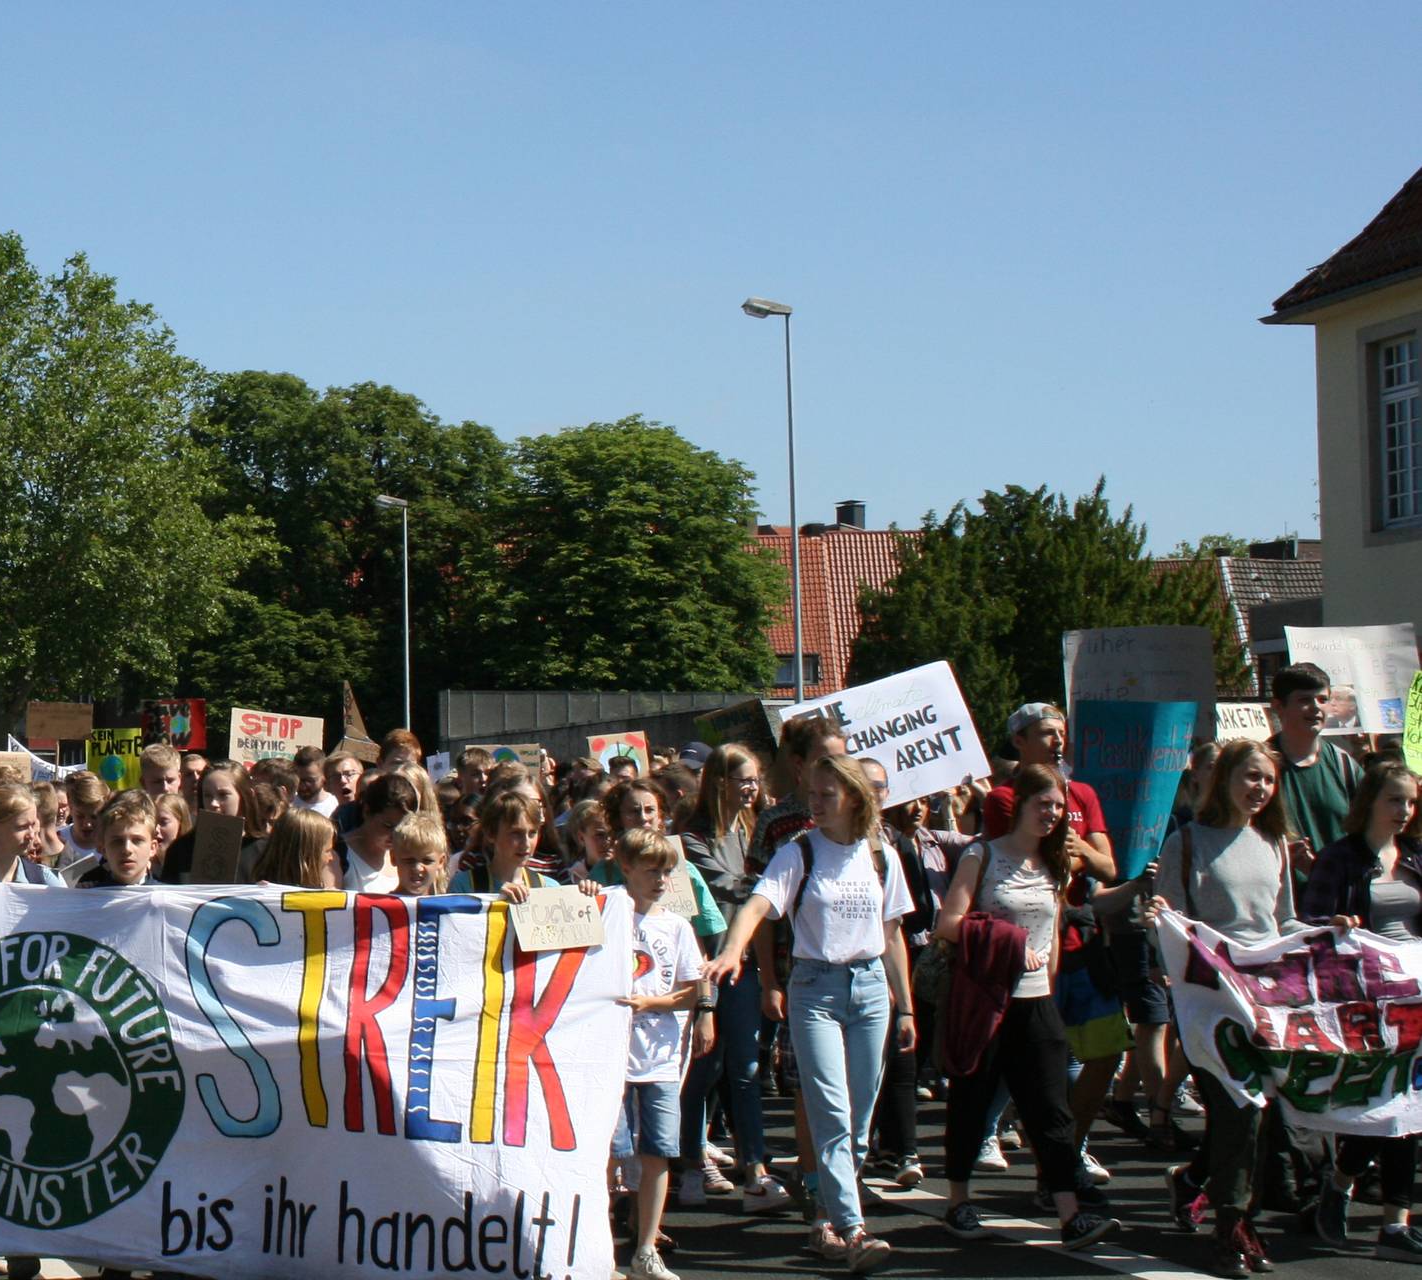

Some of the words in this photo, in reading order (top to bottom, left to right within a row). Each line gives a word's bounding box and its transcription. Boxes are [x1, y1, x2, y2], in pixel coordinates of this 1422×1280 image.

[239, 713, 303, 740] STOP
[92, 739, 135, 757] PLANET
[237, 737, 286, 752] DENYING
[841, 892, 868, 900] EQUAL
[577, 904, 592, 923] of
[832, 905, 844, 913] OF
[846, 905, 858, 913] US
[860, 905, 877, 913] ARE
[840, 912, 869, 920] EQUAL
[0, 933, 70, 987] FOR
[74, 945, 182, 1093] FUTURE
[185, 890, 607, 1152] STREIK
[160, 1180, 234, 1257] bis
[262, 1175, 317, 1258] ihr
[338, 1180, 581, 1280] handelt!
